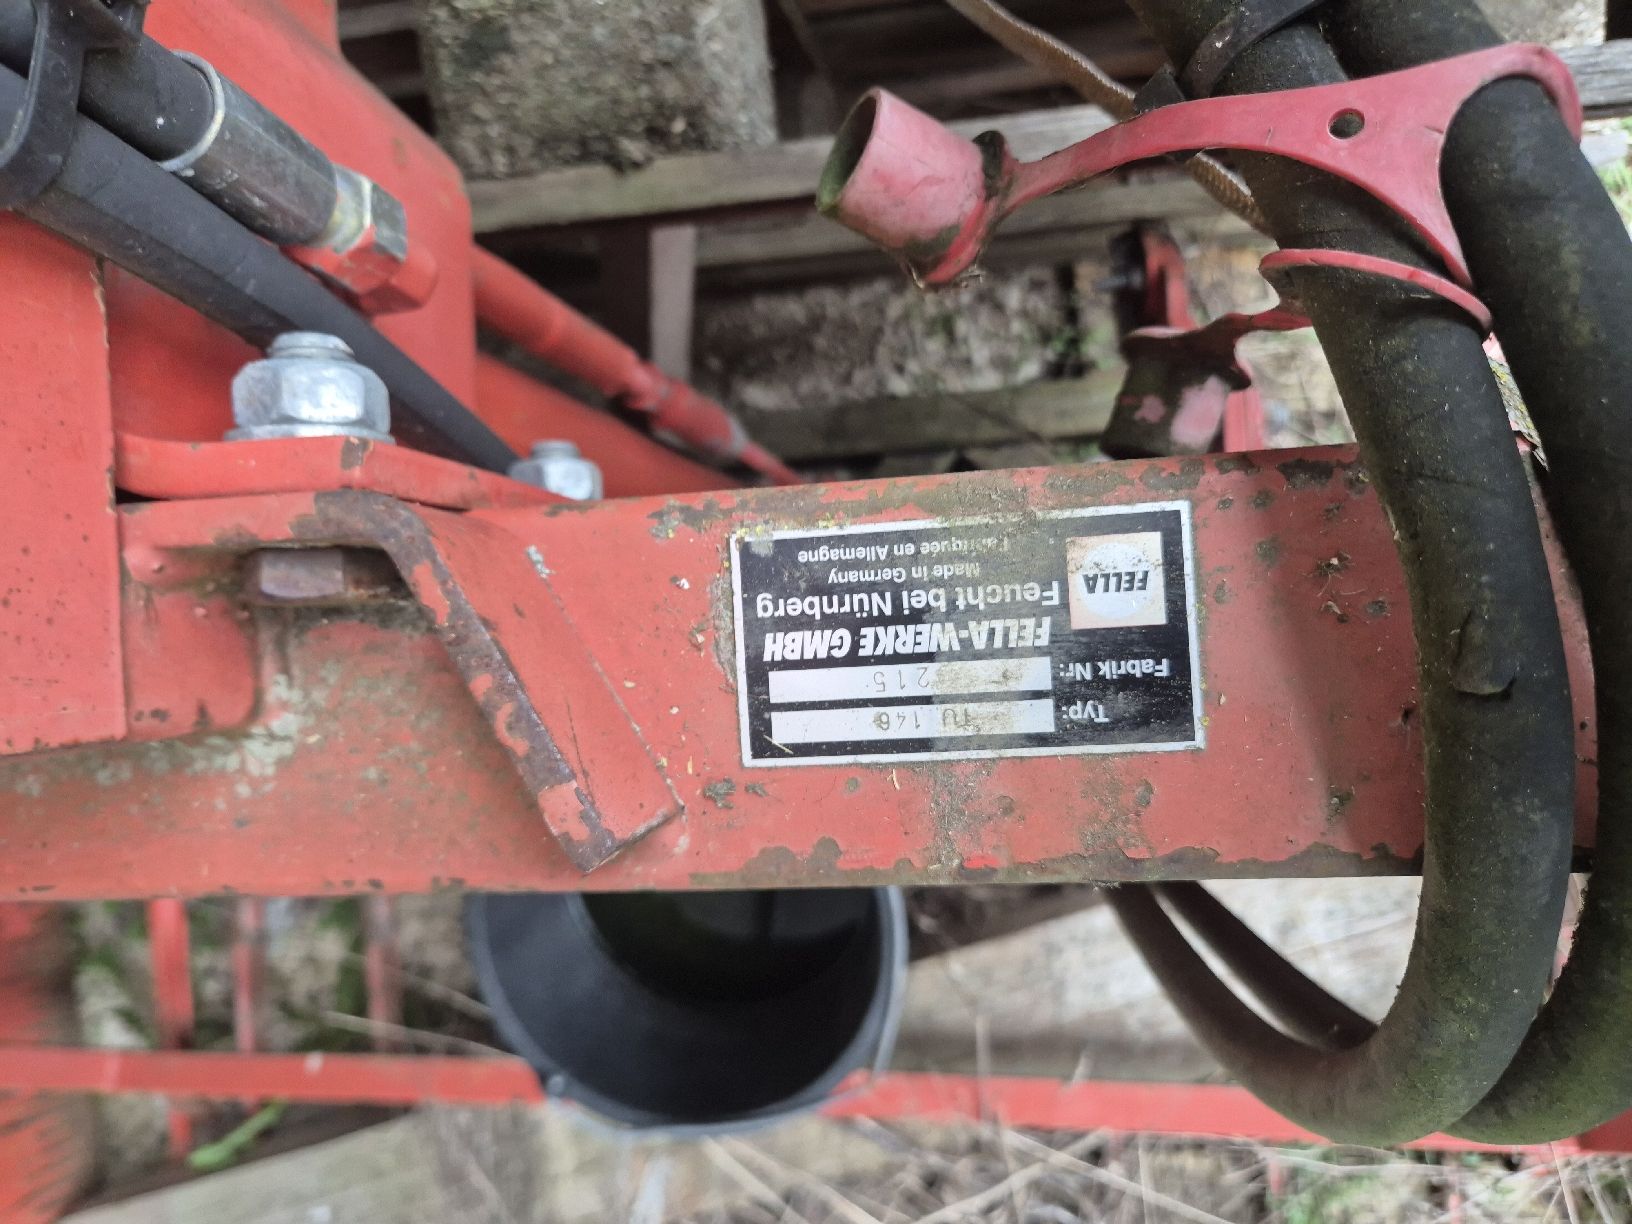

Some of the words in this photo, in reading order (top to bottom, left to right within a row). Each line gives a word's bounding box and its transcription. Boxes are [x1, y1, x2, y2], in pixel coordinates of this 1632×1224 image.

[798, 545, 888, 563] Allemagne
[893, 542, 915, 556] en
[828, 567, 906, 584] Germany
[911, 565, 928, 581] in
[932, 563, 980, 580] Made
[1082, 570, 1149, 594] FELLA
[756, 591, 892, 620] Nürnberg
[901, 587, 946, 615] bei
[954, 580, 1060, 611] Feucht
[763, 628, 851, 662] GMBH
[858, 616, 1051, 657] FELLA-WERKE
[1060, 661, 1093, 681] Nr:
[1098, 658, 1171, 680] Fabrik
[943, 708, 972, 729] TU
[1062, 700, 1110, 723] Typ:
